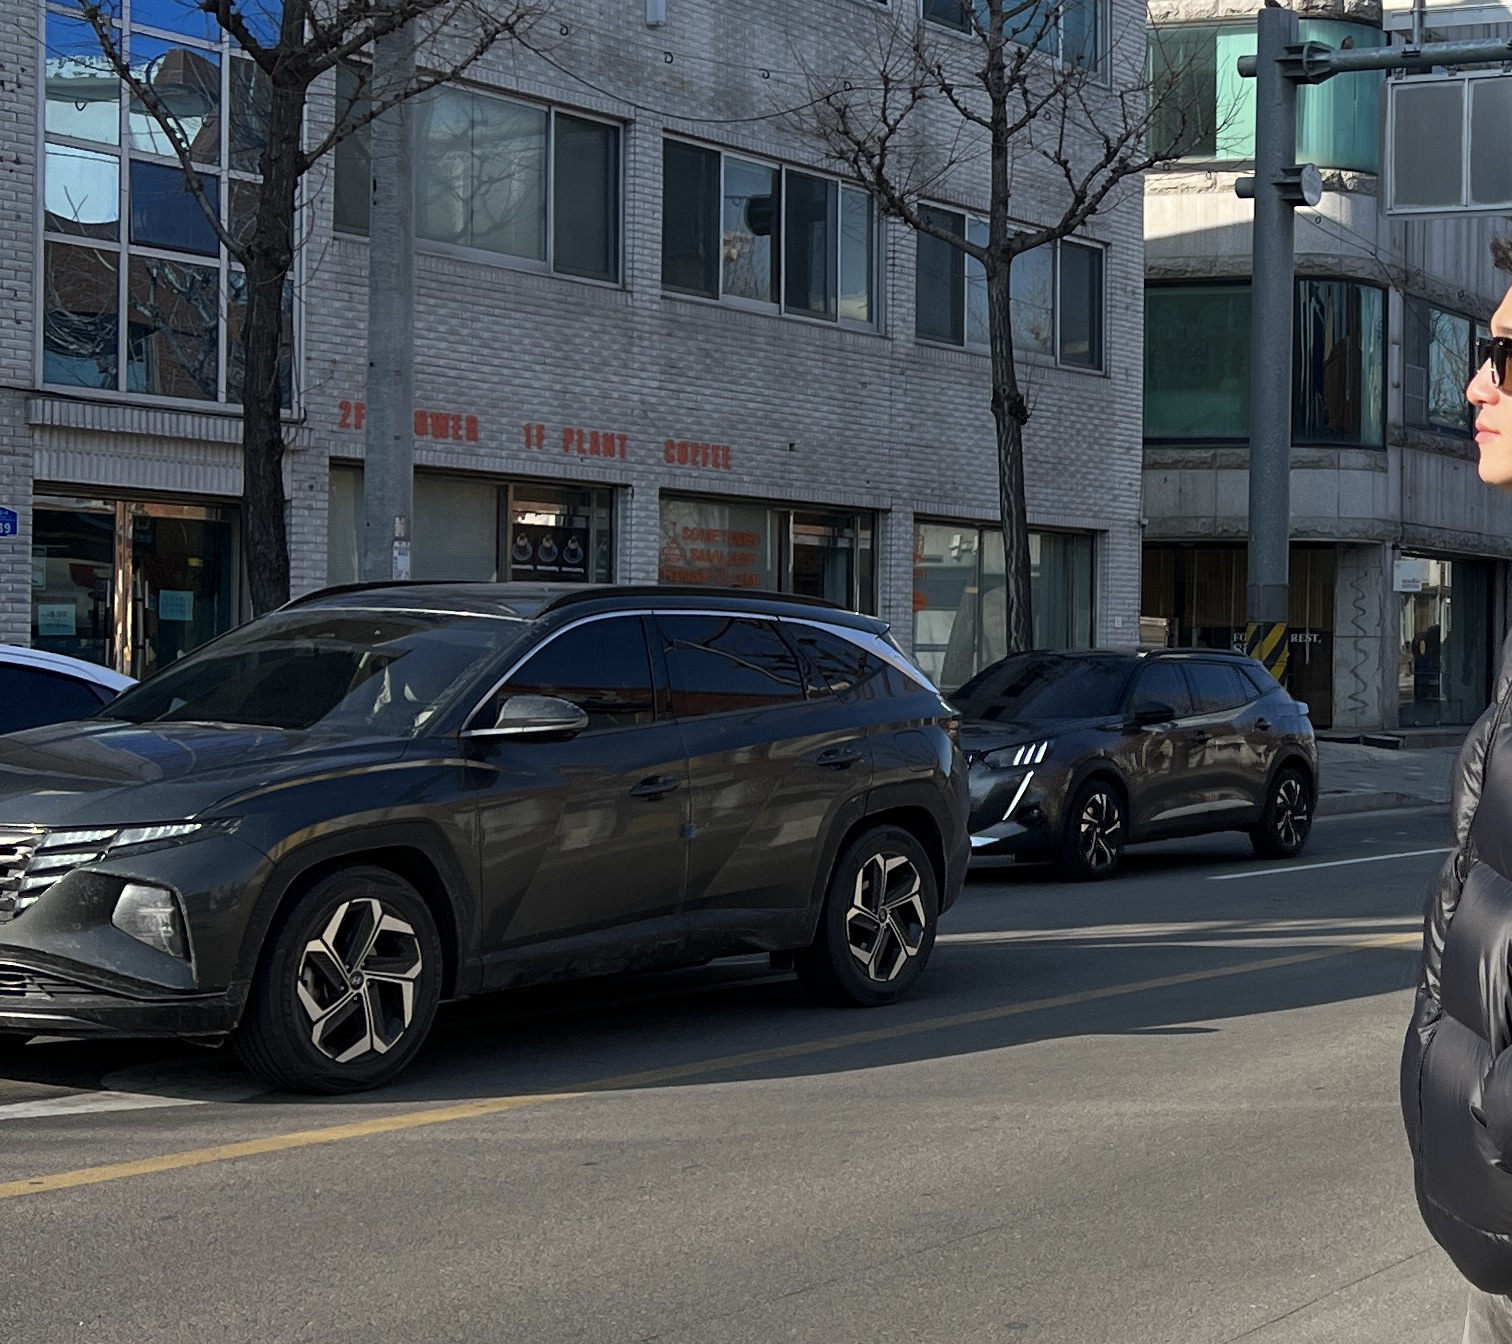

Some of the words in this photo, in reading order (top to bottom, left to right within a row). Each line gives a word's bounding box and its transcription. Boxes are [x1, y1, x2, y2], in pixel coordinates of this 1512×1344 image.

[413, 409, 479, 442] OWER
[522, 422, 546, 450] 1F
[562, 426, 628, 459] PLANT
[663, 438, 732, 471] COFFEE
